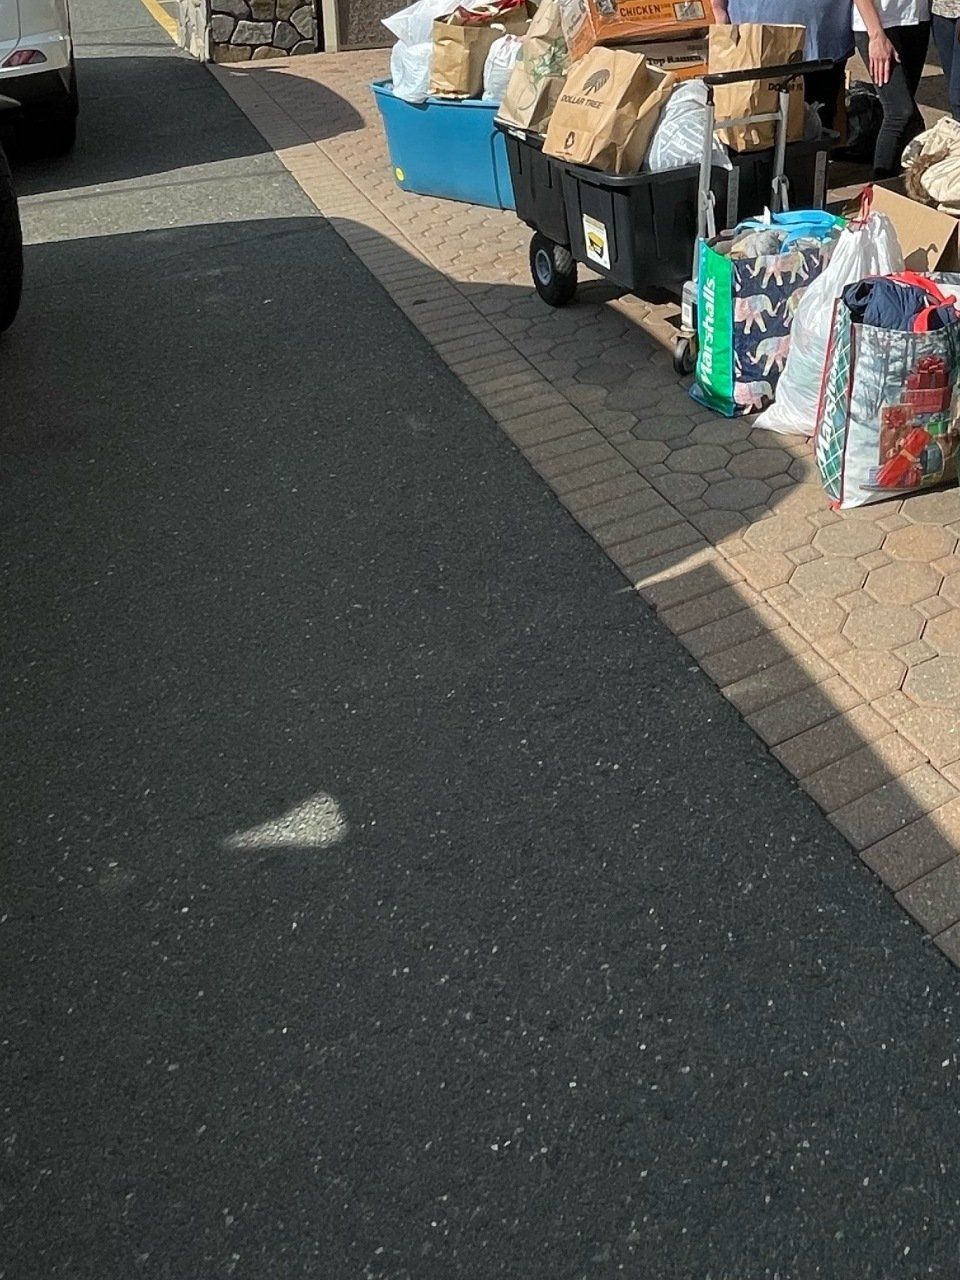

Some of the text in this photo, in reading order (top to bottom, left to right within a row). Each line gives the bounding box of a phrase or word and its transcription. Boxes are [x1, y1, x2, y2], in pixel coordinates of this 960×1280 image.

[620, 4, 661, 17] CHICKEN
[646, 54, 704, 66] Top Ramen
[560, 94, 603, 110] DOLLAR TREE
[699, 277, 716, 396] Marshalls
